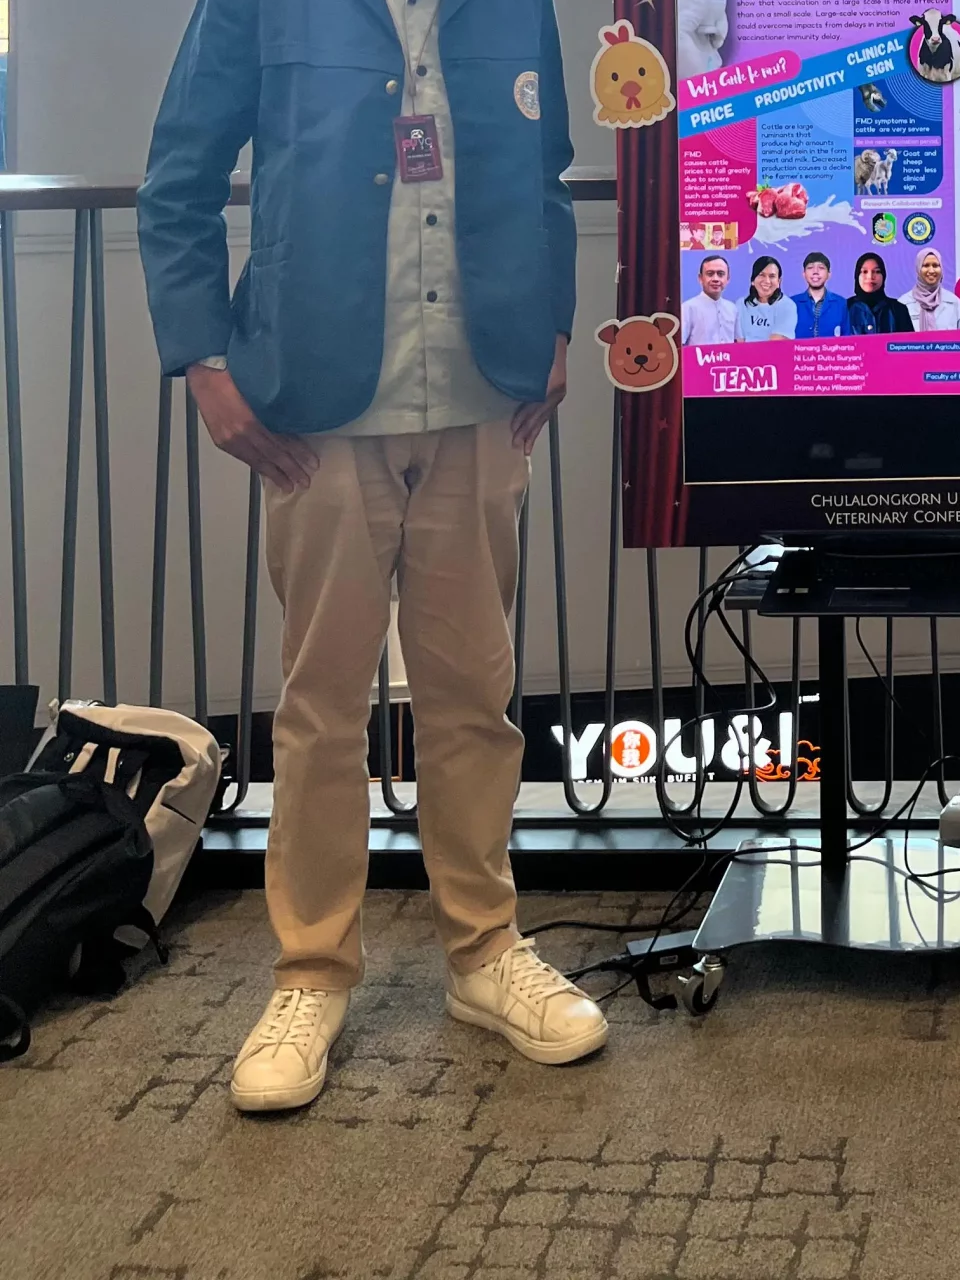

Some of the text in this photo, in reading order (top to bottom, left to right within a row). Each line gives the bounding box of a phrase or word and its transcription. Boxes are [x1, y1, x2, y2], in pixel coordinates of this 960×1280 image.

[737, 10, 754, 18] than
[815, 10, 858, 18] Large-scale
[859, 9, 901, 17] vaccination
[847, 38, 904, 66] CLINICAL
[866, 58, 895, 78] SIGN
[754, 70, 846, 108] PRODUCTIVITY
[690, 103, 735, 128] PRICE
[874, 118, 908, 126] symptoms
[903, 158, 923, 166] sheep
[903, 183, 917, 192] sign
[750, 315, 770, 327] Vet.
[710, 365, 778, 392] TEAM
[811, 493, 941, 508] CHULALONGKORN
[825, 511, 908, 525] VETERINARY
